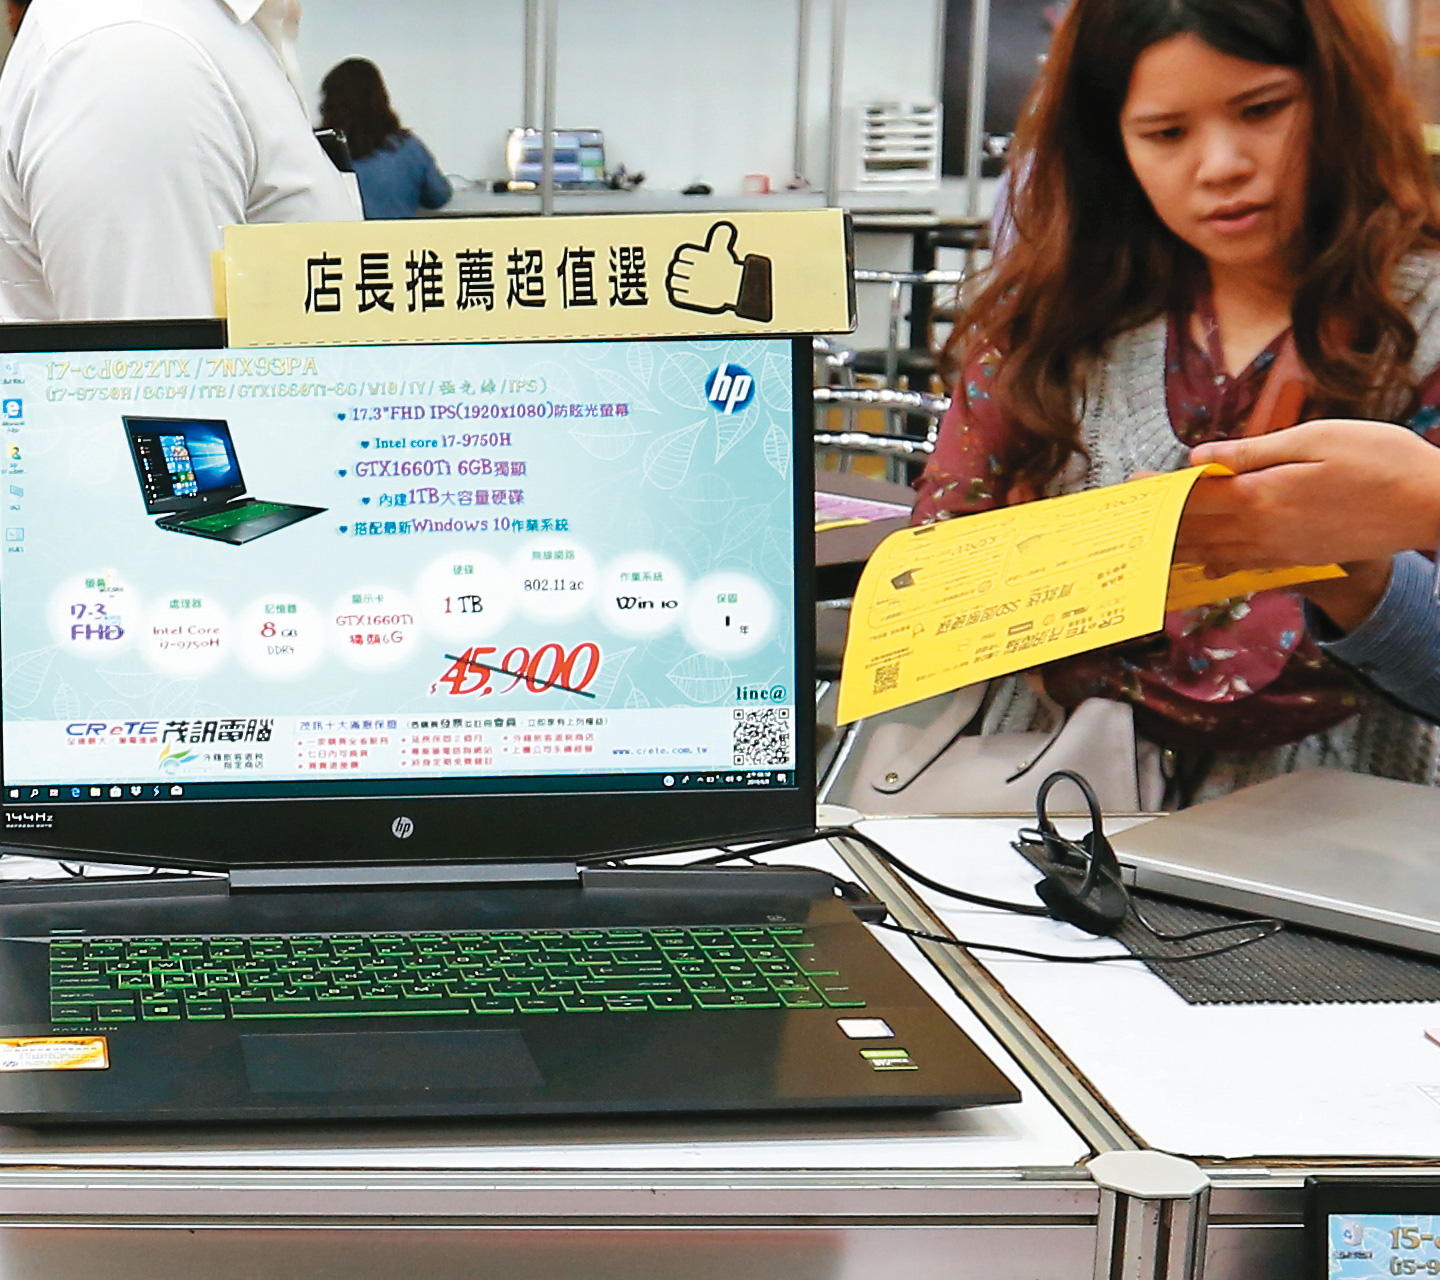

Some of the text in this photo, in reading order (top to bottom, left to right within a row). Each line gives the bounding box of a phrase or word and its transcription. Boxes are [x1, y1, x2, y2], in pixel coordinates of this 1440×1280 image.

[302, 244, 651, 317] 店長推薦超值選
[707, 363, 753, 415] hp
[375, 437, 407, 450] Intel
[409, 438, 438, 449] core
[523, 578, 585, 592] 802.11 ac
[457, 595, 484, 614] TB
[616, 596, 655, 610] Win
[260, 621, 277, 638] 8
[391, 816, 415, 839] hp
